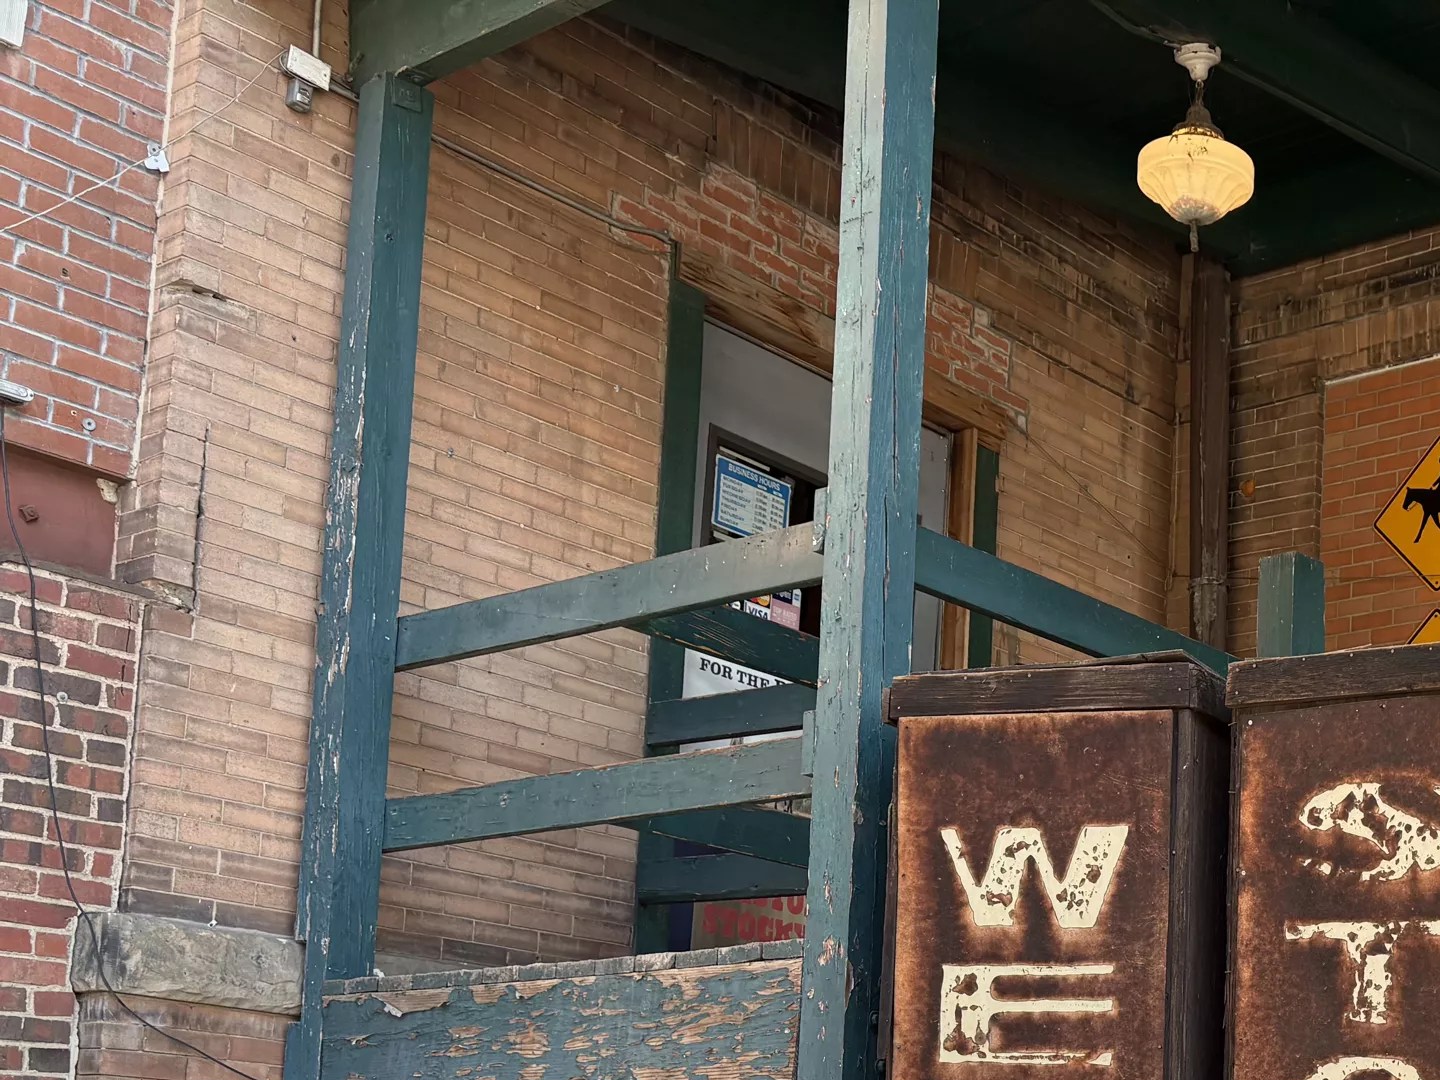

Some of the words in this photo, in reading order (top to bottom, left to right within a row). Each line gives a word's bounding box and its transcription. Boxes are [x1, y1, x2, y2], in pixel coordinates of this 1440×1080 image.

[728, 463, 758, 483] BUSINESS
[758, 476, 781, 491] HOURS
[747, 604, 769, 621] VISA
[699, 656, 734, 681] FOR
[736, 669, 770, 689] THE
